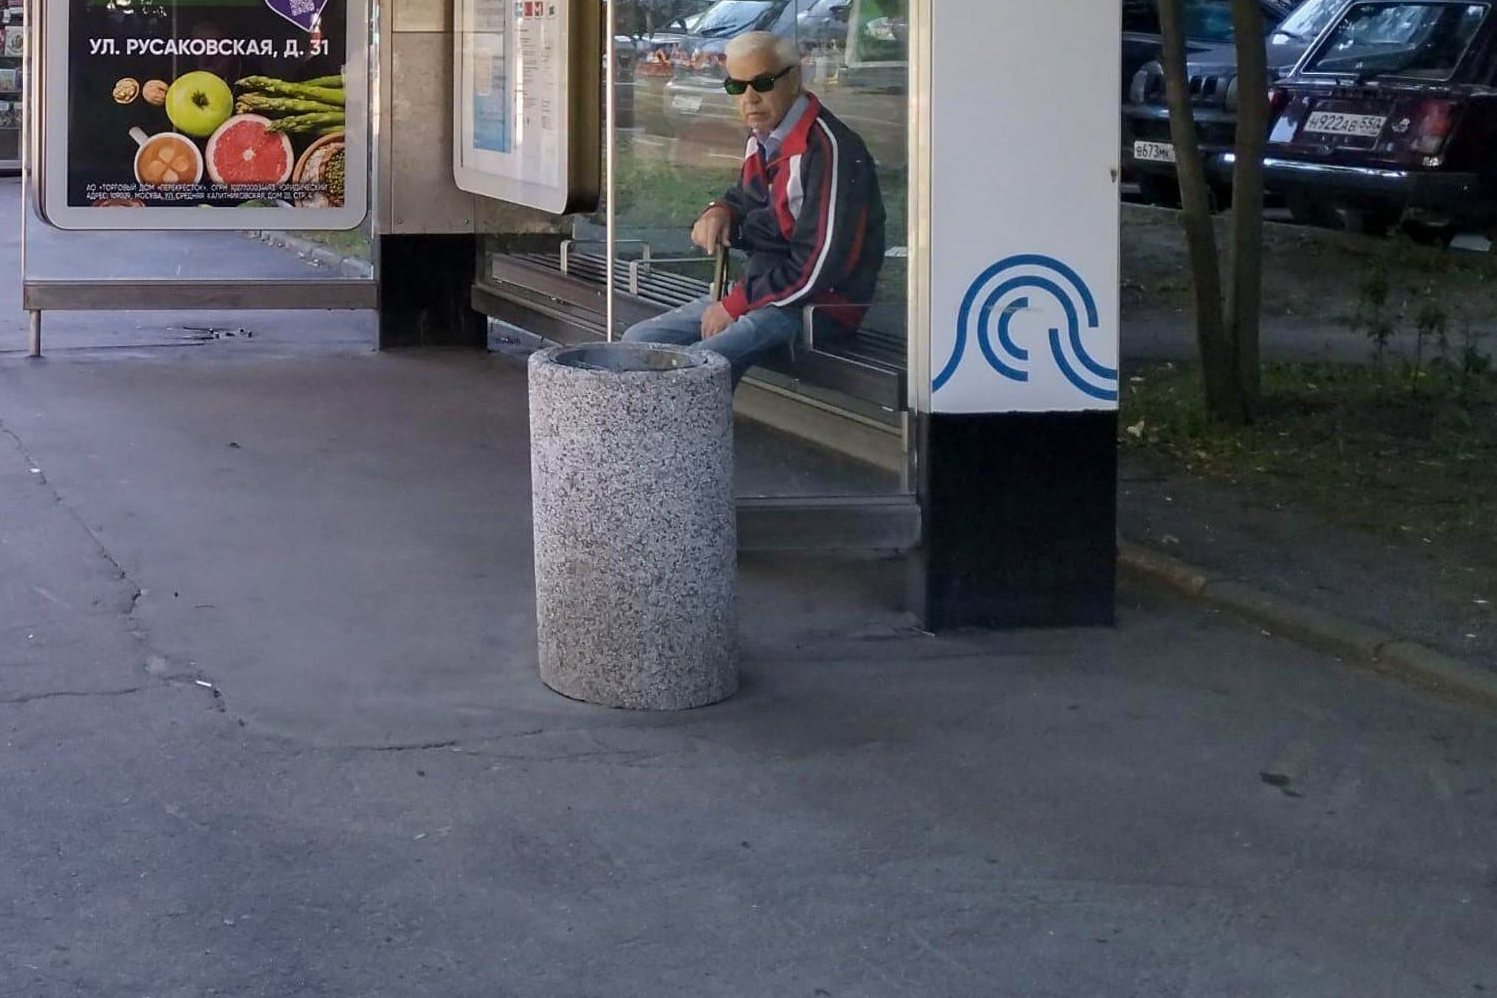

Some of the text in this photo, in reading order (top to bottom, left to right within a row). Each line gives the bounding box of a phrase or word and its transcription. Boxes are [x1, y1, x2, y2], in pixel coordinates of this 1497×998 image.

[89, 38, 329, 58] УЛ. РУСАКОВСКАЯ, Д. 31
